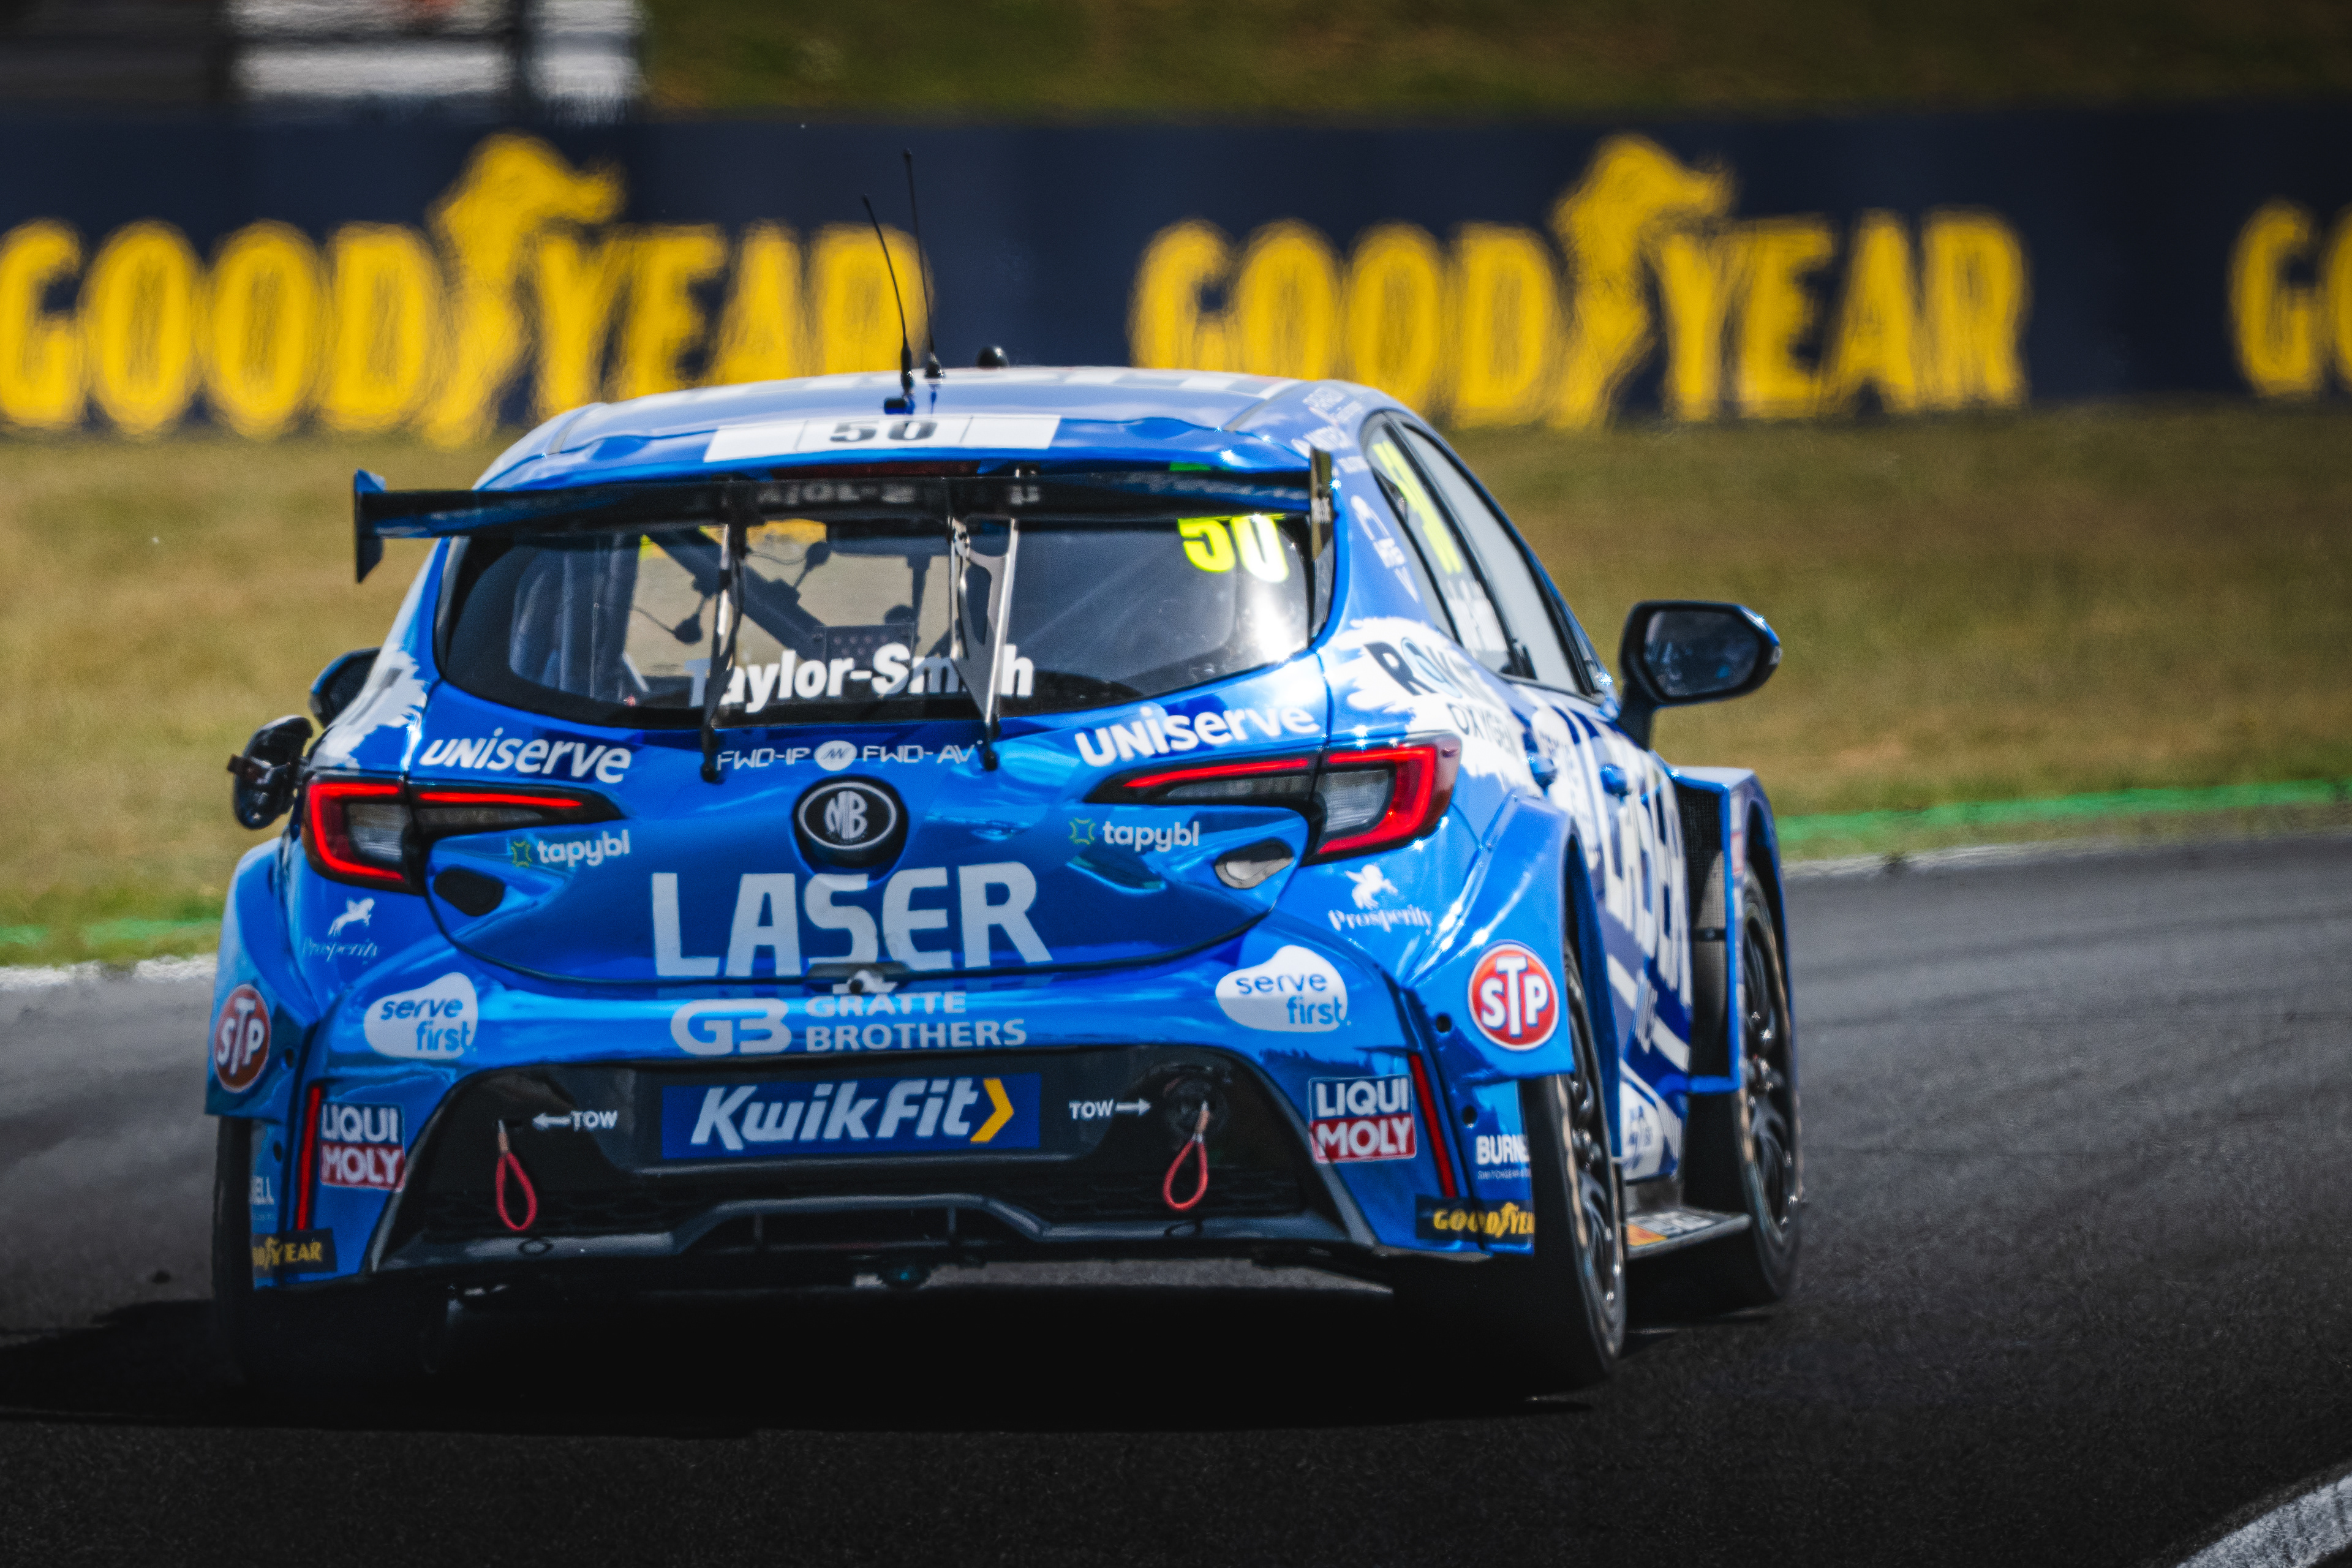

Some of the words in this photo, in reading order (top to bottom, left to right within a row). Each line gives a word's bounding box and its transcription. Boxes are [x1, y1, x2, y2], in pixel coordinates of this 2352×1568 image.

[0, 205, 934, 438] GOODYEAR
[1128, 202, 2034, 432] GOODYEAR
[829, 420, 938, 442] 50
[1178, 514, 1289, 582] 50
[684, 643, 1035, 713] Taylor-Smh
[537, 829, 631, 867] tapybl
[1103, 821, 1200, 853] tapybl
[651, 861, 1054, 978] LASER
[805, 991, 967, 1017] GRATTE
[1235, 974, 1327, 995] serve
[1480, 956, 1549, 1038] STP
[380, 998, 464, 1020] serve
[217, 997, 266, 1076] STP
[805, 1019, 1027, 1052] BROTHERS
[1069, 1101, 1115, 1118] TOW
[1315, 1077, 1409, 1117] LIQUI
[322, 1103, 399, 1144] LIQUI
[571, 1109, 618, 1129] TOW
[1316, 1116, 1411, 1157] MOLY
[321, 1145, 402, 1185] MOLY
